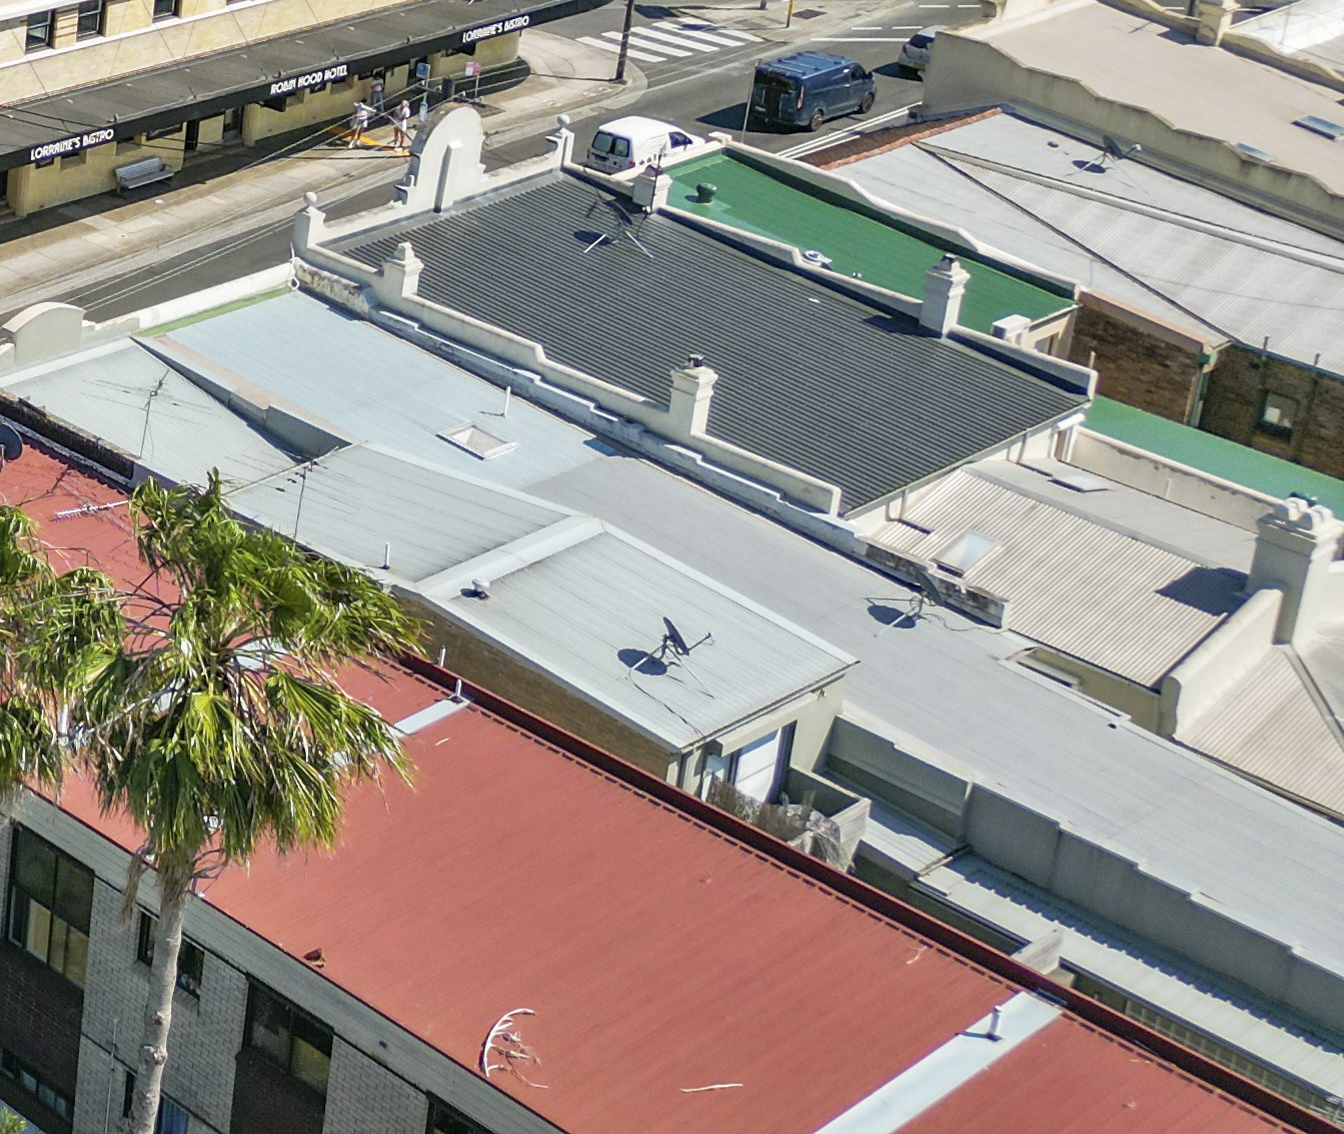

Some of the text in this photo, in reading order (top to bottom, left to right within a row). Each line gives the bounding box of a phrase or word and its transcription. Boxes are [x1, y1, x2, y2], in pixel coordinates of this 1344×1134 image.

[298, 71, 323, 87] HOOD
[324, 65, 348, 81] HOTEL
[30, 129, 114, 161] LORRAINE'S BISTRO
